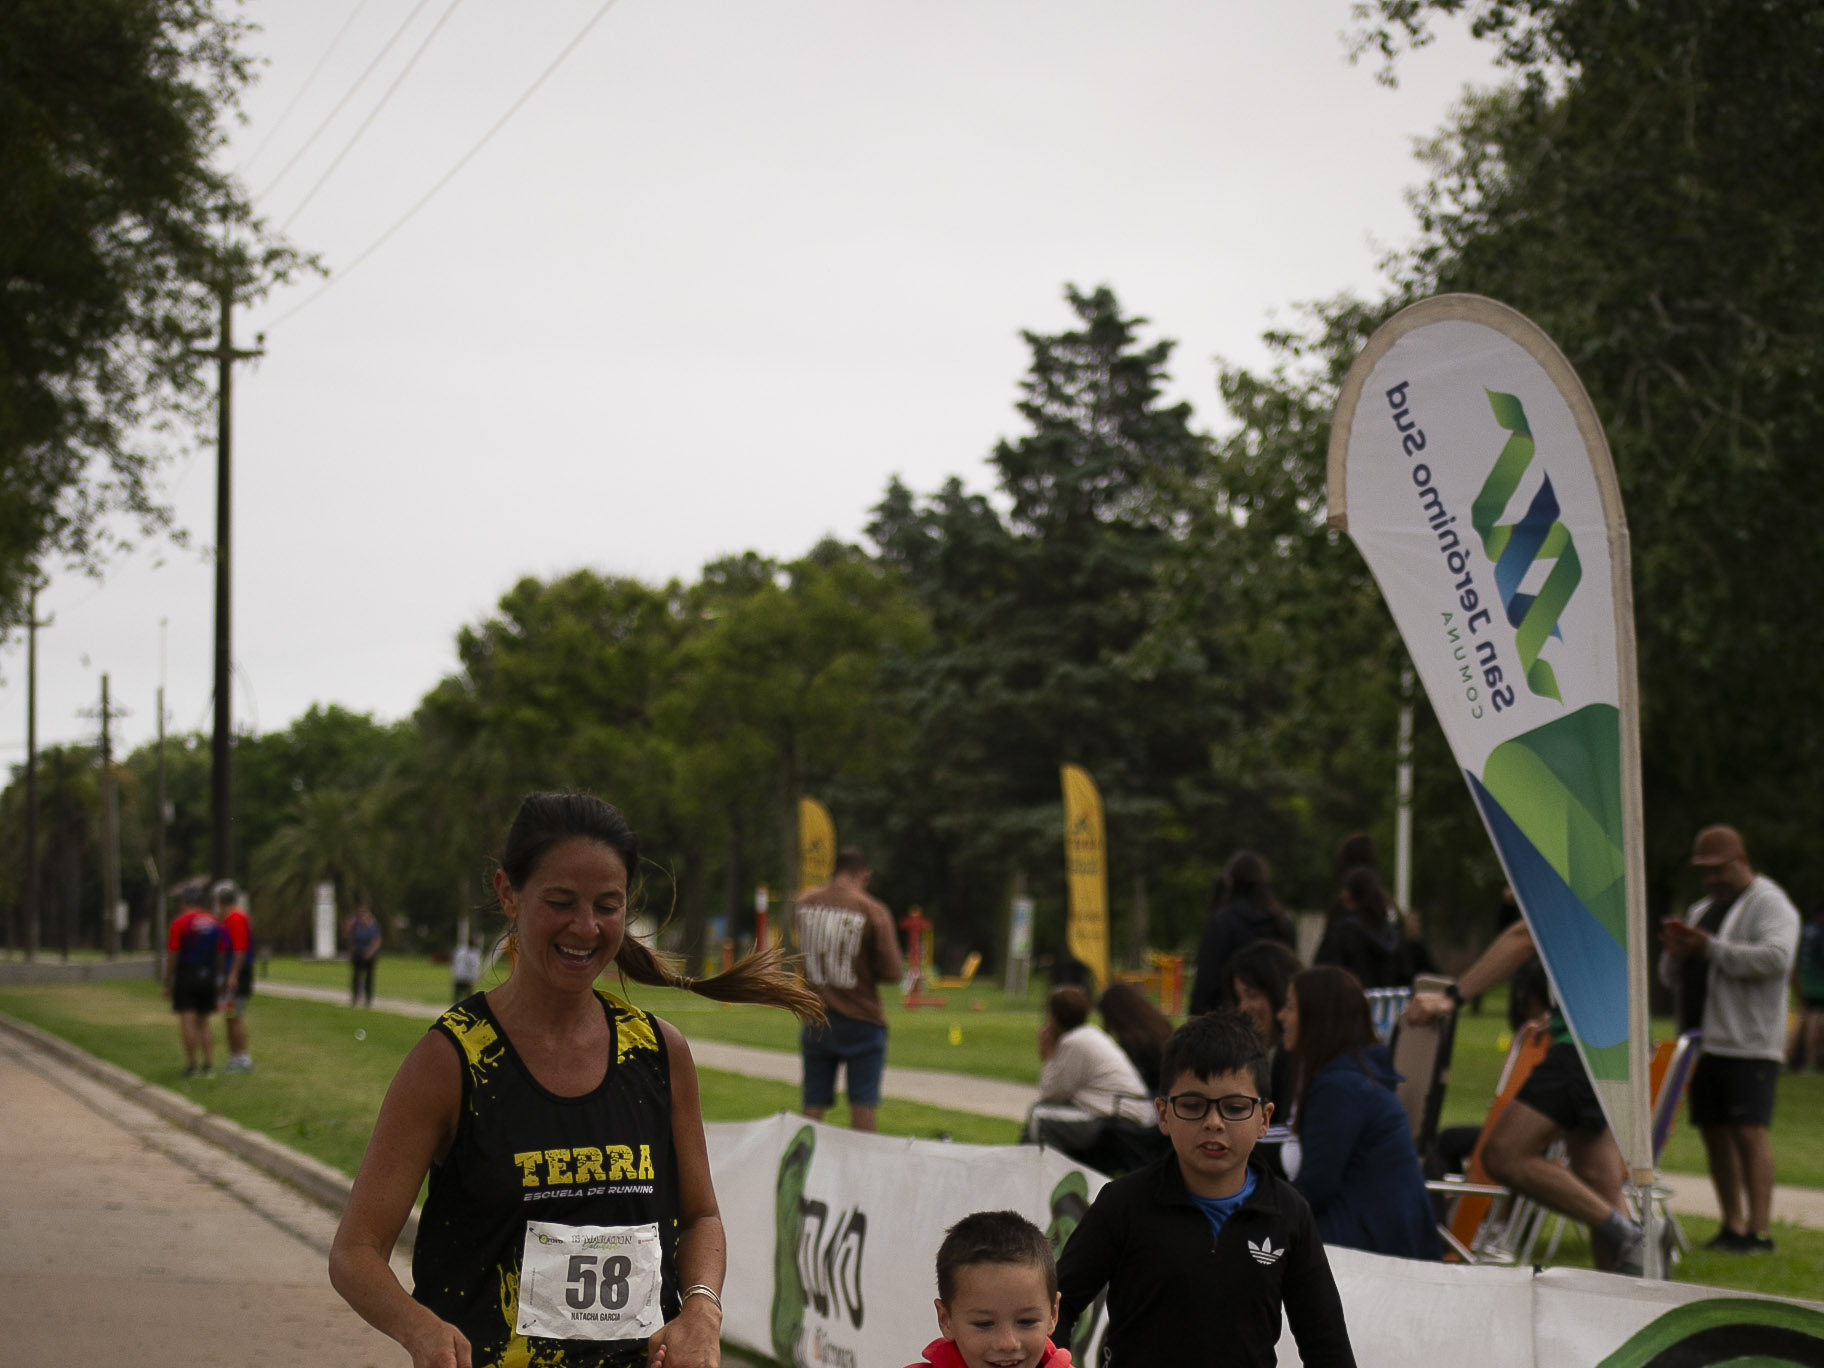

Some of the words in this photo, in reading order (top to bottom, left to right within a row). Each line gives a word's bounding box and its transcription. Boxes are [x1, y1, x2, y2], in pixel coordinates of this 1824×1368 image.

[514, 1144, 655, 1188] TERRA
[523, 1189, 584, 1202] ESCUELA
[587, 1186, 606, 1197] DE
[608, 1185, 654, 1195] RUNNING
[565, 1255, 632, 1310] 58
[570, 1312, 599, 1321] NATACHA
[600, 1312, 621, 1322] GARCIA
